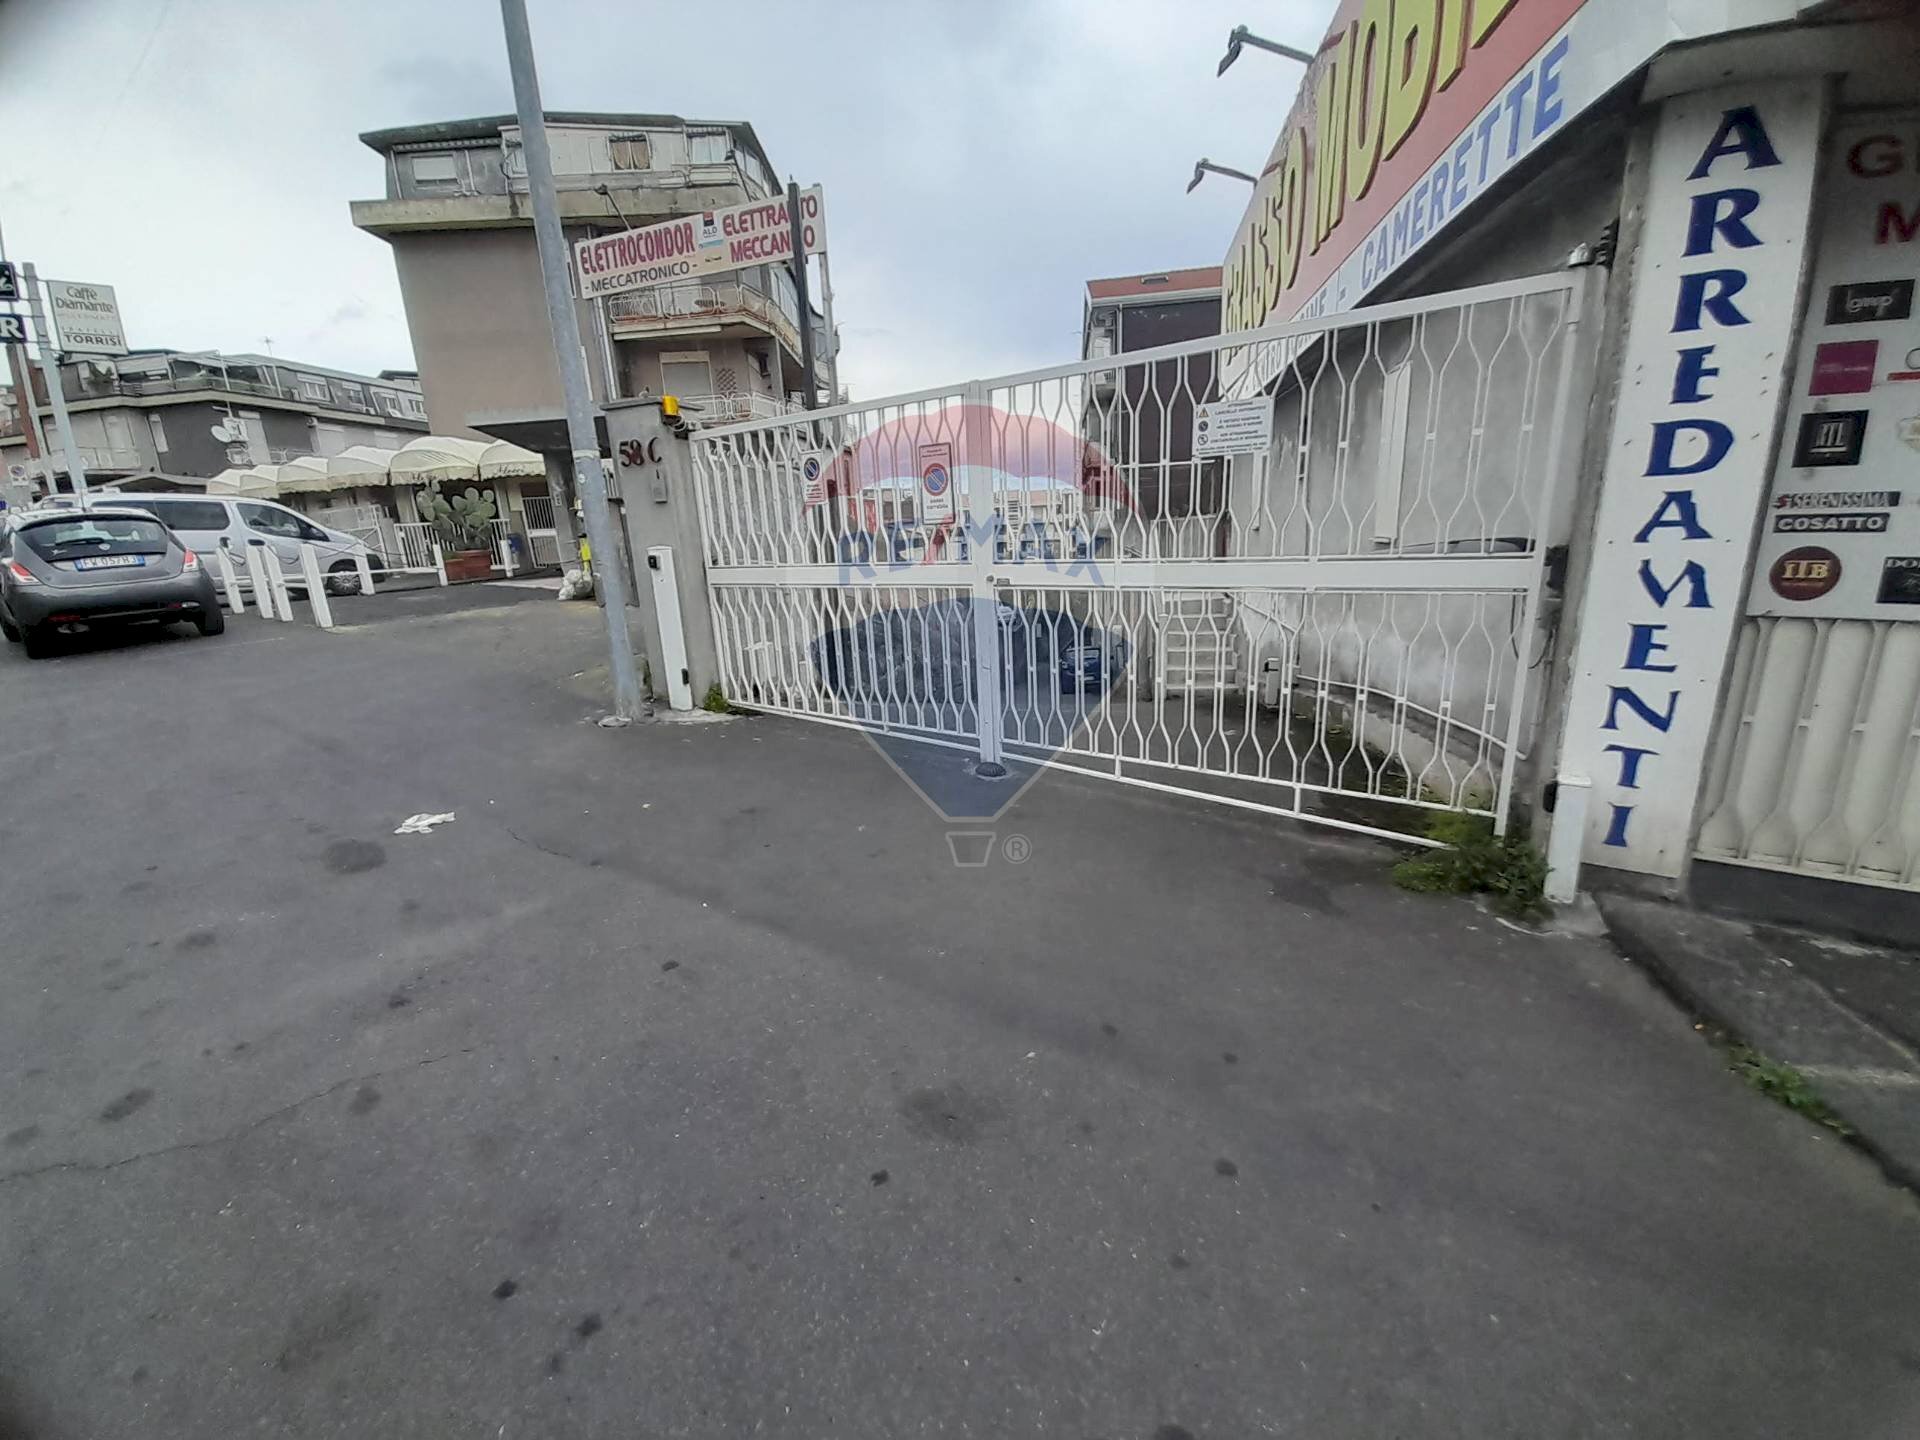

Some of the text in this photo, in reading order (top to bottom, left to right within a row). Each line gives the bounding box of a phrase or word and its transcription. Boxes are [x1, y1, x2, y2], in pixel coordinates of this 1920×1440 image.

[1361, 34, 1569, 290] CAMERETTE
[722, 195, 818, 237] ELETTRATO
[580, 222, 696, 275] ELETTROCONDOR
[729, 224, 815, 263] MECCANO
[591, 260, 690, 292] MECCATRONICO
[55, 296, 114, 314] Diamante
[64, 334, 122, 347] TORRISI
[1599, 104, 1782, 848] ARREDAMENTI
[1792, 490, 1890, 508] SERENISSIMA
[1778, 517, 1884, 530] COSATTO
